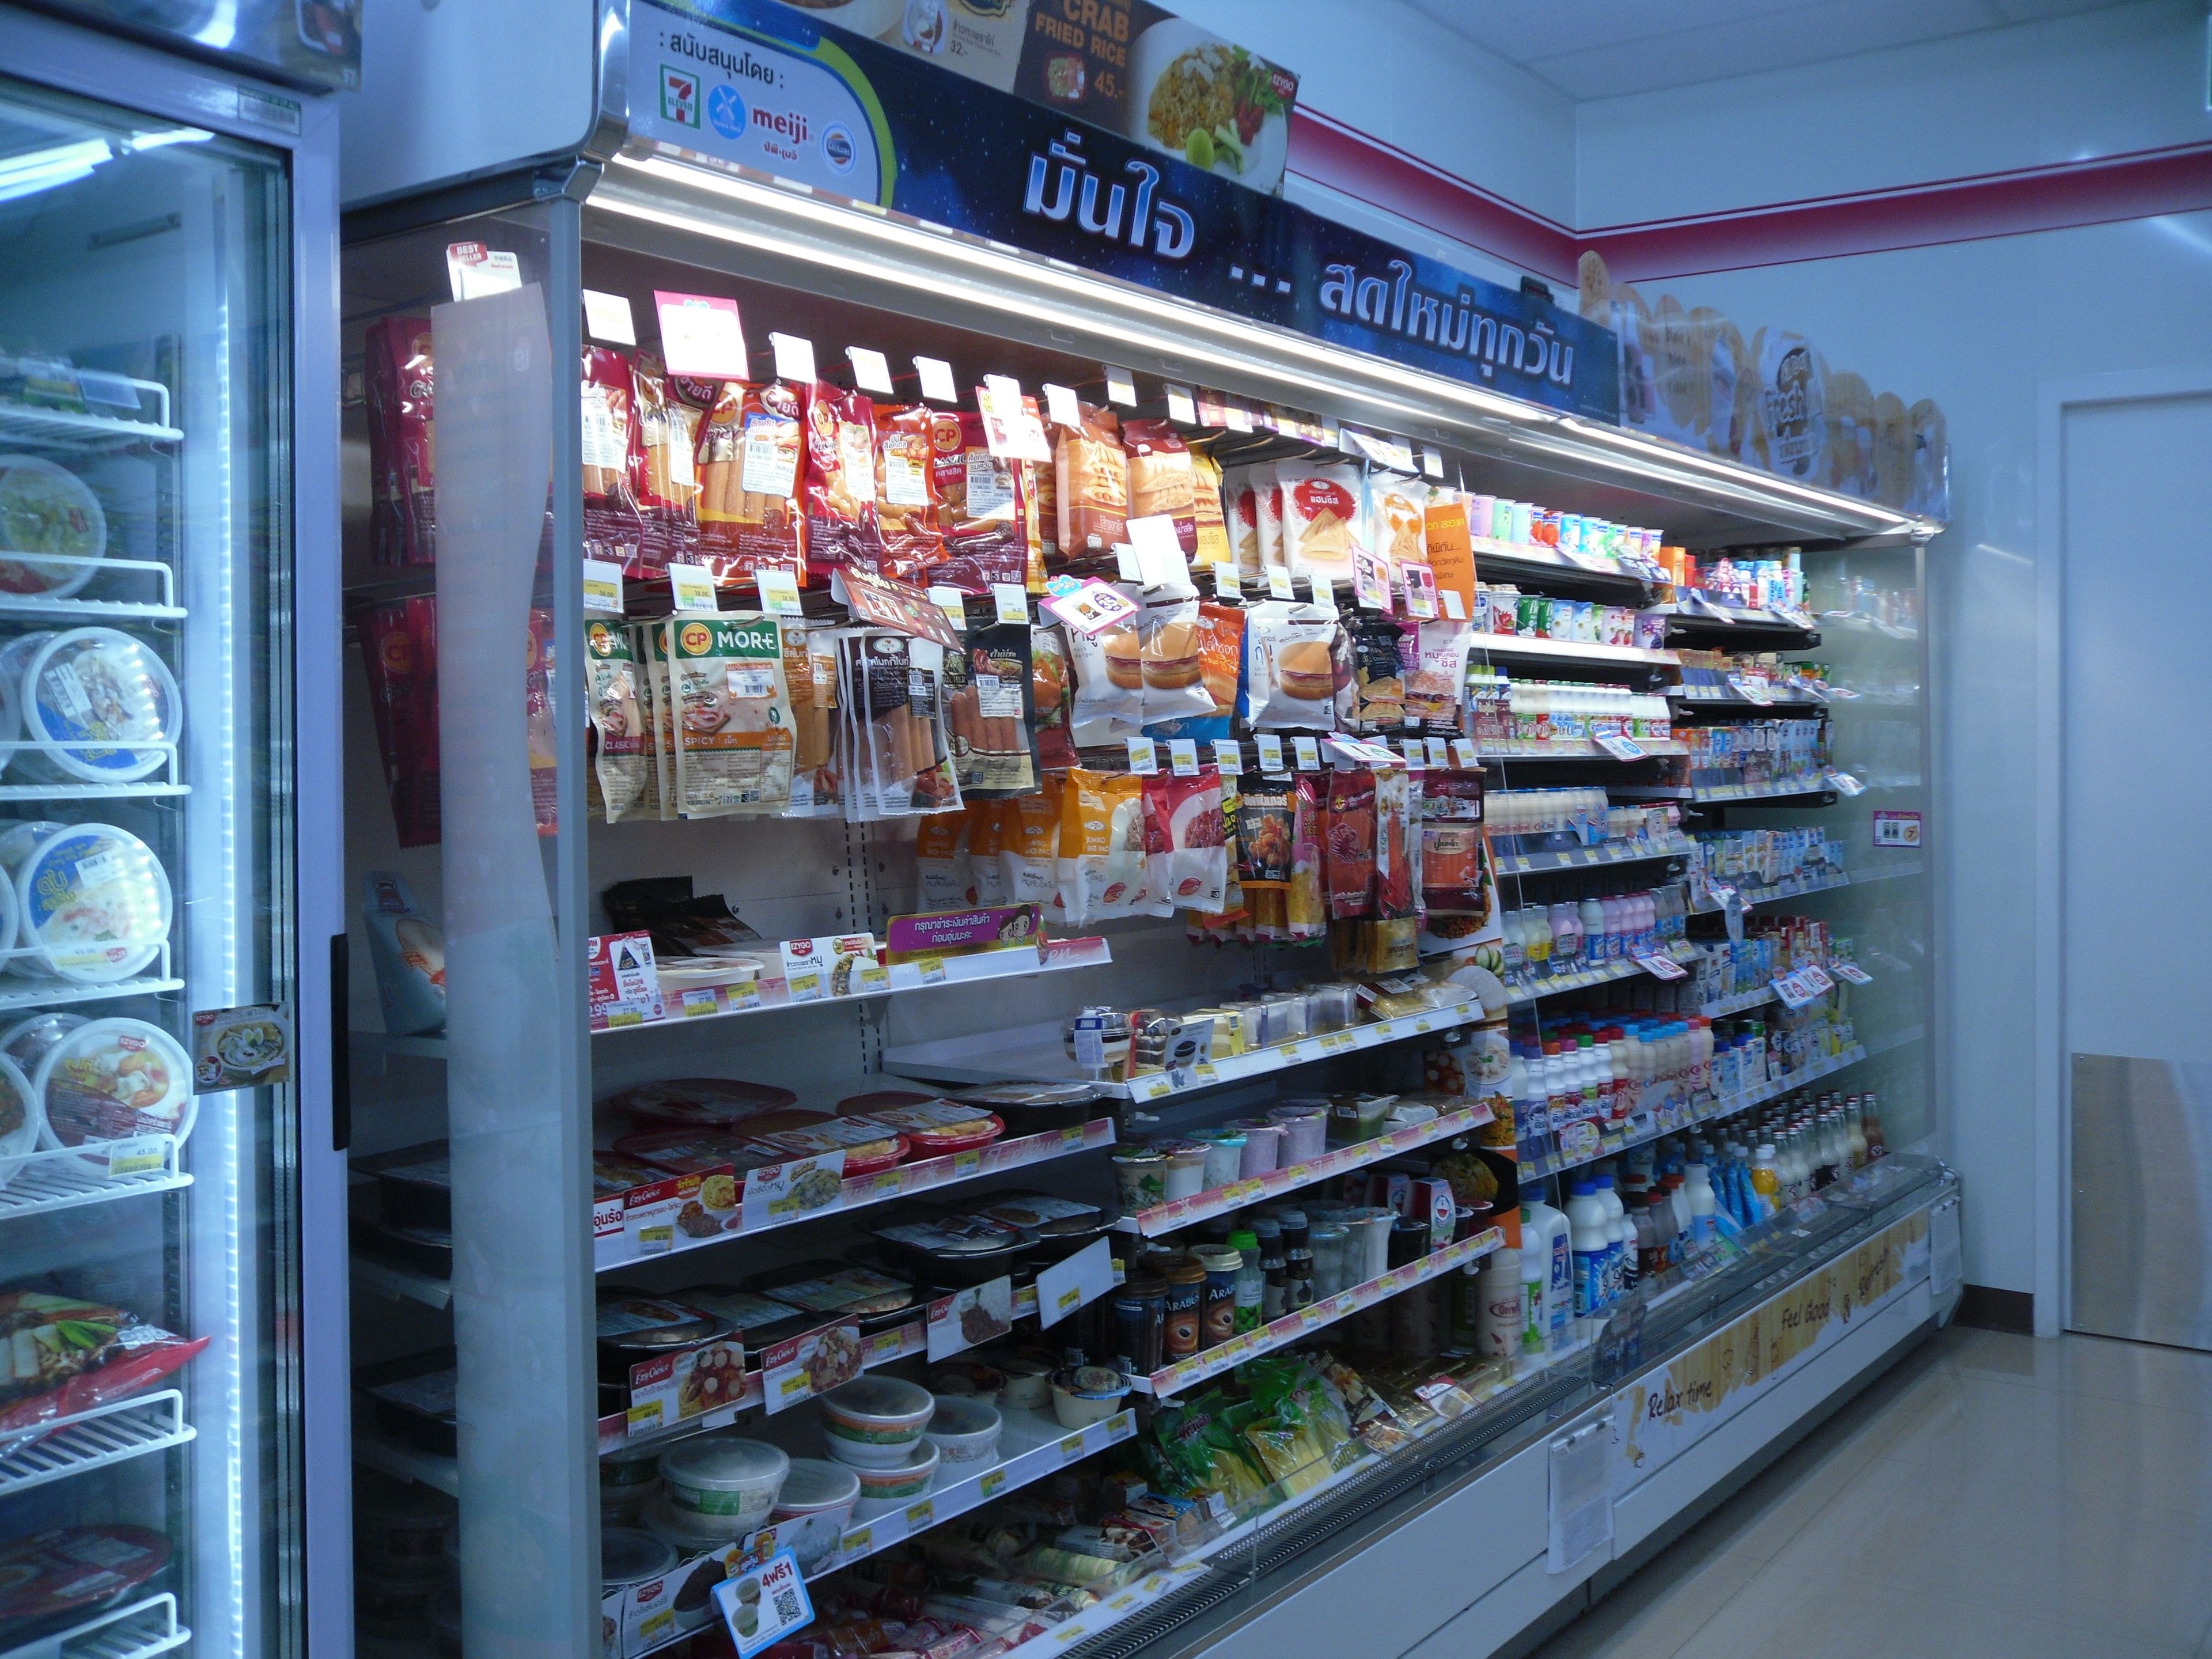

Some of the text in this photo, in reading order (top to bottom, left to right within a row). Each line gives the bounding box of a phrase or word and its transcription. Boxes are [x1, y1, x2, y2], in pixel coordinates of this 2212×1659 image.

[1035, 13, 1127, 68] FRIED RICE
[1272, 74, 1294, 90] EZYGO
[752, 108, 807, 144] meiji
[457, 244, 479, 255] BEST
[1024, 128, 1194, 259] มั่นใจ
[1319, 259, 1574, 385] สดใหม่ทุกวัน
[934, 429, 956, 442] CP
[1310, 495, 1339, 505] แฮมชีส
[685, 632, 707, 646] CP
[685, 737, 714, 745] SPICY
[915, 913, 990, 933] กรุณาชำระเงินค่าสินค้า
[931, 930, 972, 944] ก่อนอุ่นนะคะ
[790, 941, 811, 949] EZYGO
[120, 1036, 145, 1048] EZYGO
[758, 1166, 780, 1176] EZYGO
[594, 1207, 623, 1230] อุ่นร้อ
[1782, 1303, 1803, 1331] Feel
[1647, 1380, 1712, 1421] Relax time
